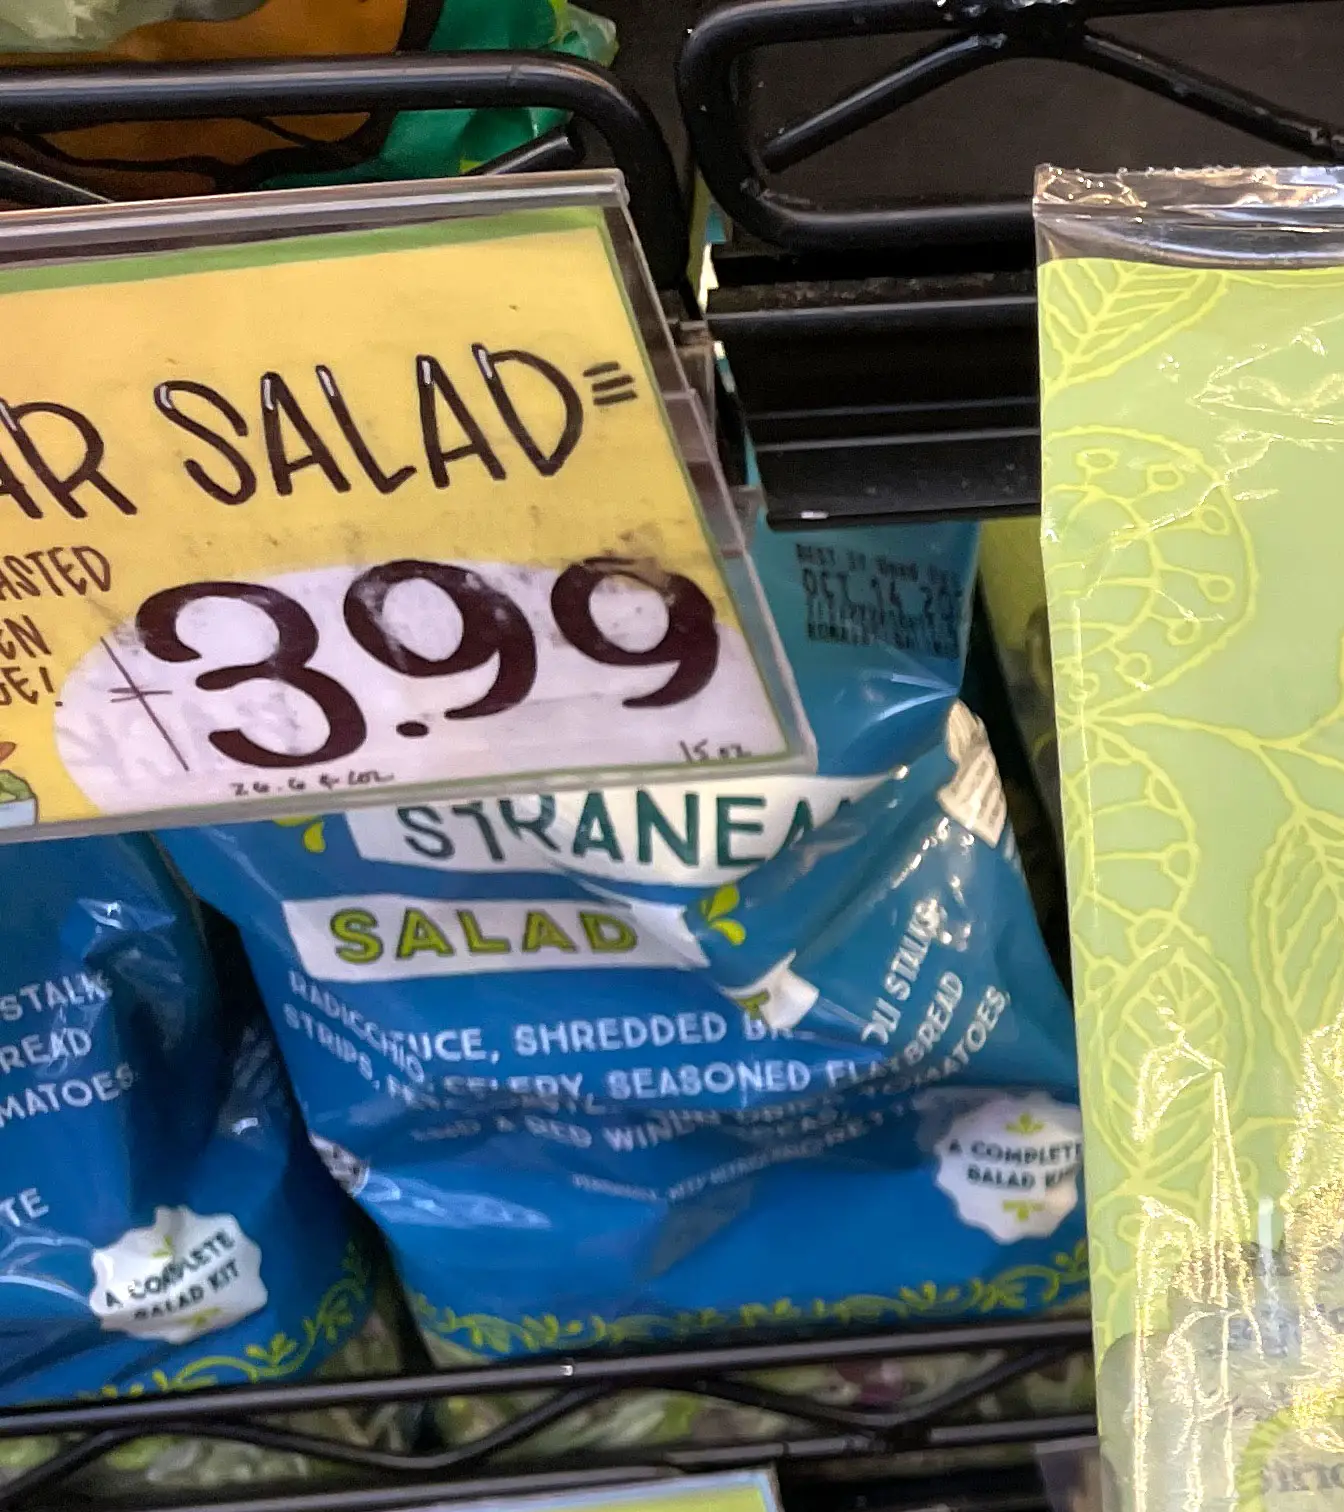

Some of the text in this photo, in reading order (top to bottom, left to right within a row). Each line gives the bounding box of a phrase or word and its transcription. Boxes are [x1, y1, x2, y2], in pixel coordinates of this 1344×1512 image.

[153, 343, 585, 504] SALAD
[330, 908, 640, 965] SALAD
[513, 1010, 728, 1058] SHREDDED
[209, 1257, 243, 1295] KIT
